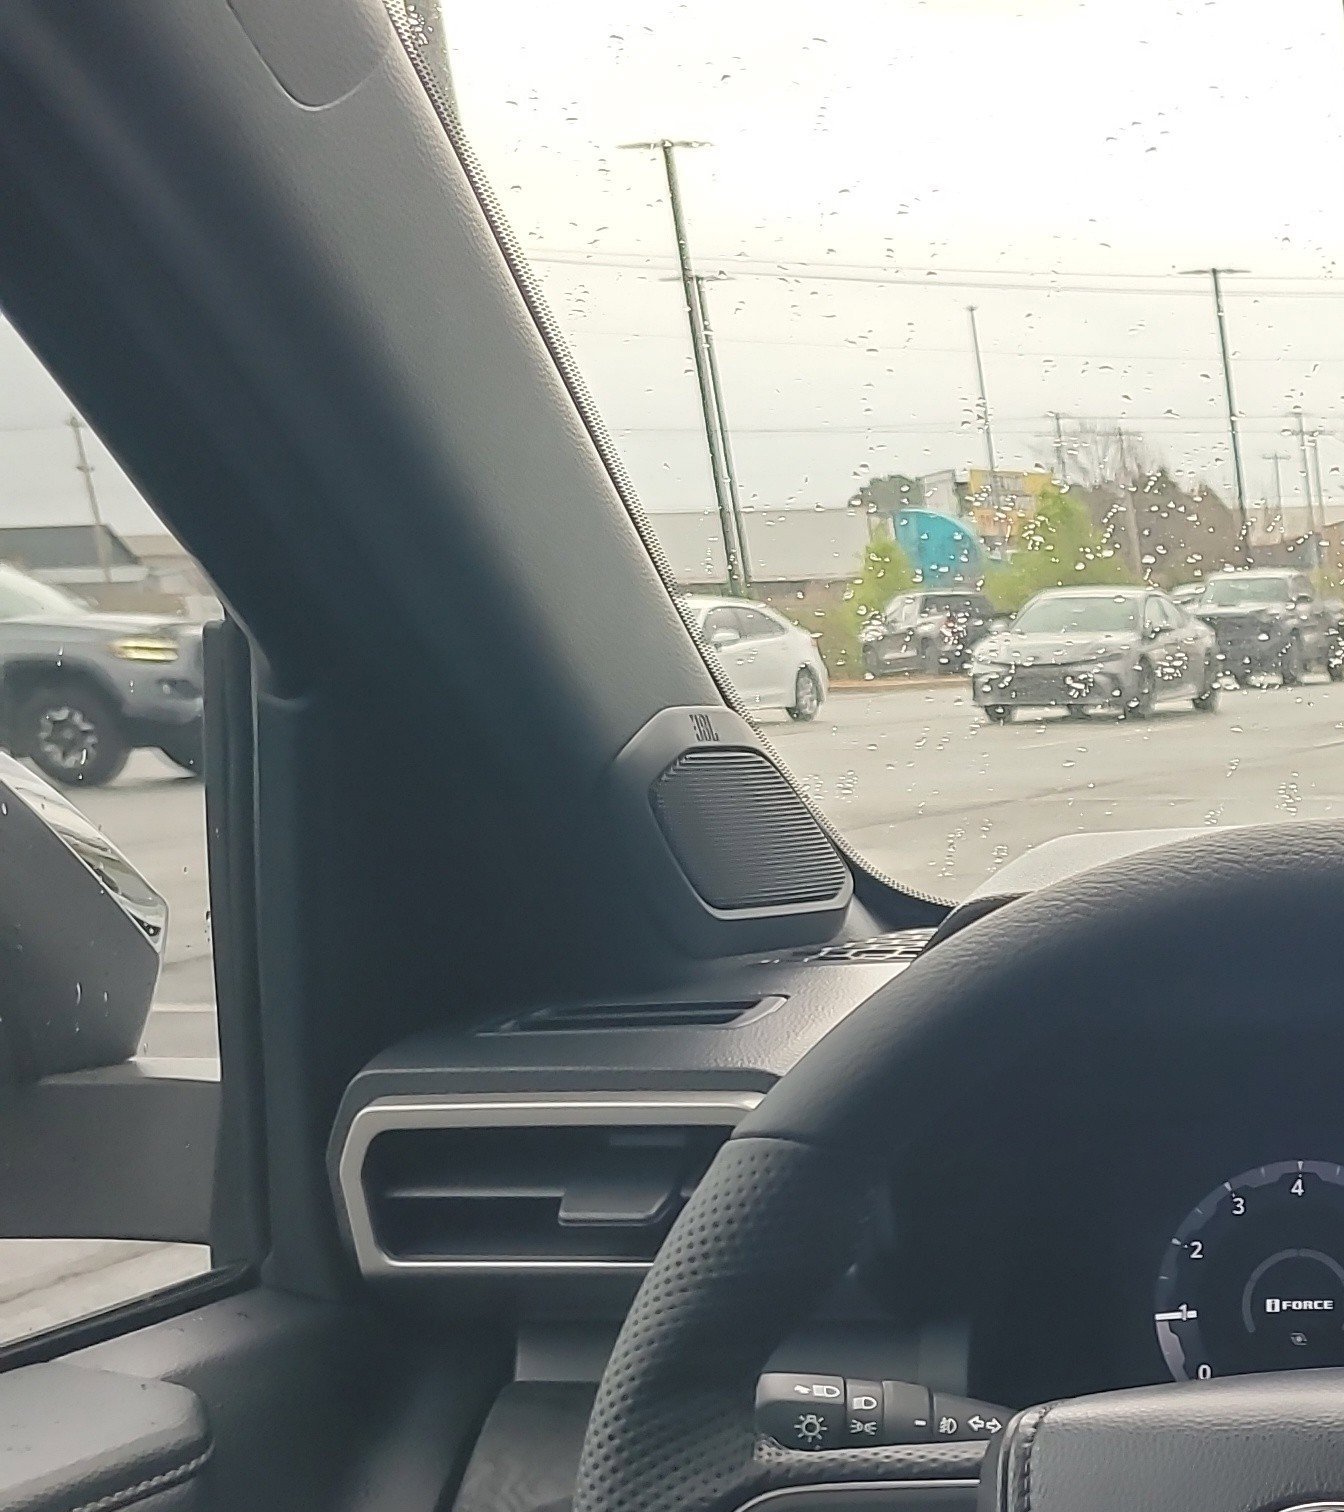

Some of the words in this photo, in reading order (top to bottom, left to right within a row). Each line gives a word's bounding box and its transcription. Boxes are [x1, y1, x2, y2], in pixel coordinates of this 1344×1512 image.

[689, 714, 720, 741] JBL
[1290, 1178, 1305, 1197] 4
[1231, 1197, 1246, 1215] 3
[1189, 1241, 1204, 1259] 2
[1178, 1303, 1188, 1321] 1
[1197, 1363, 1212, 1380] 0
